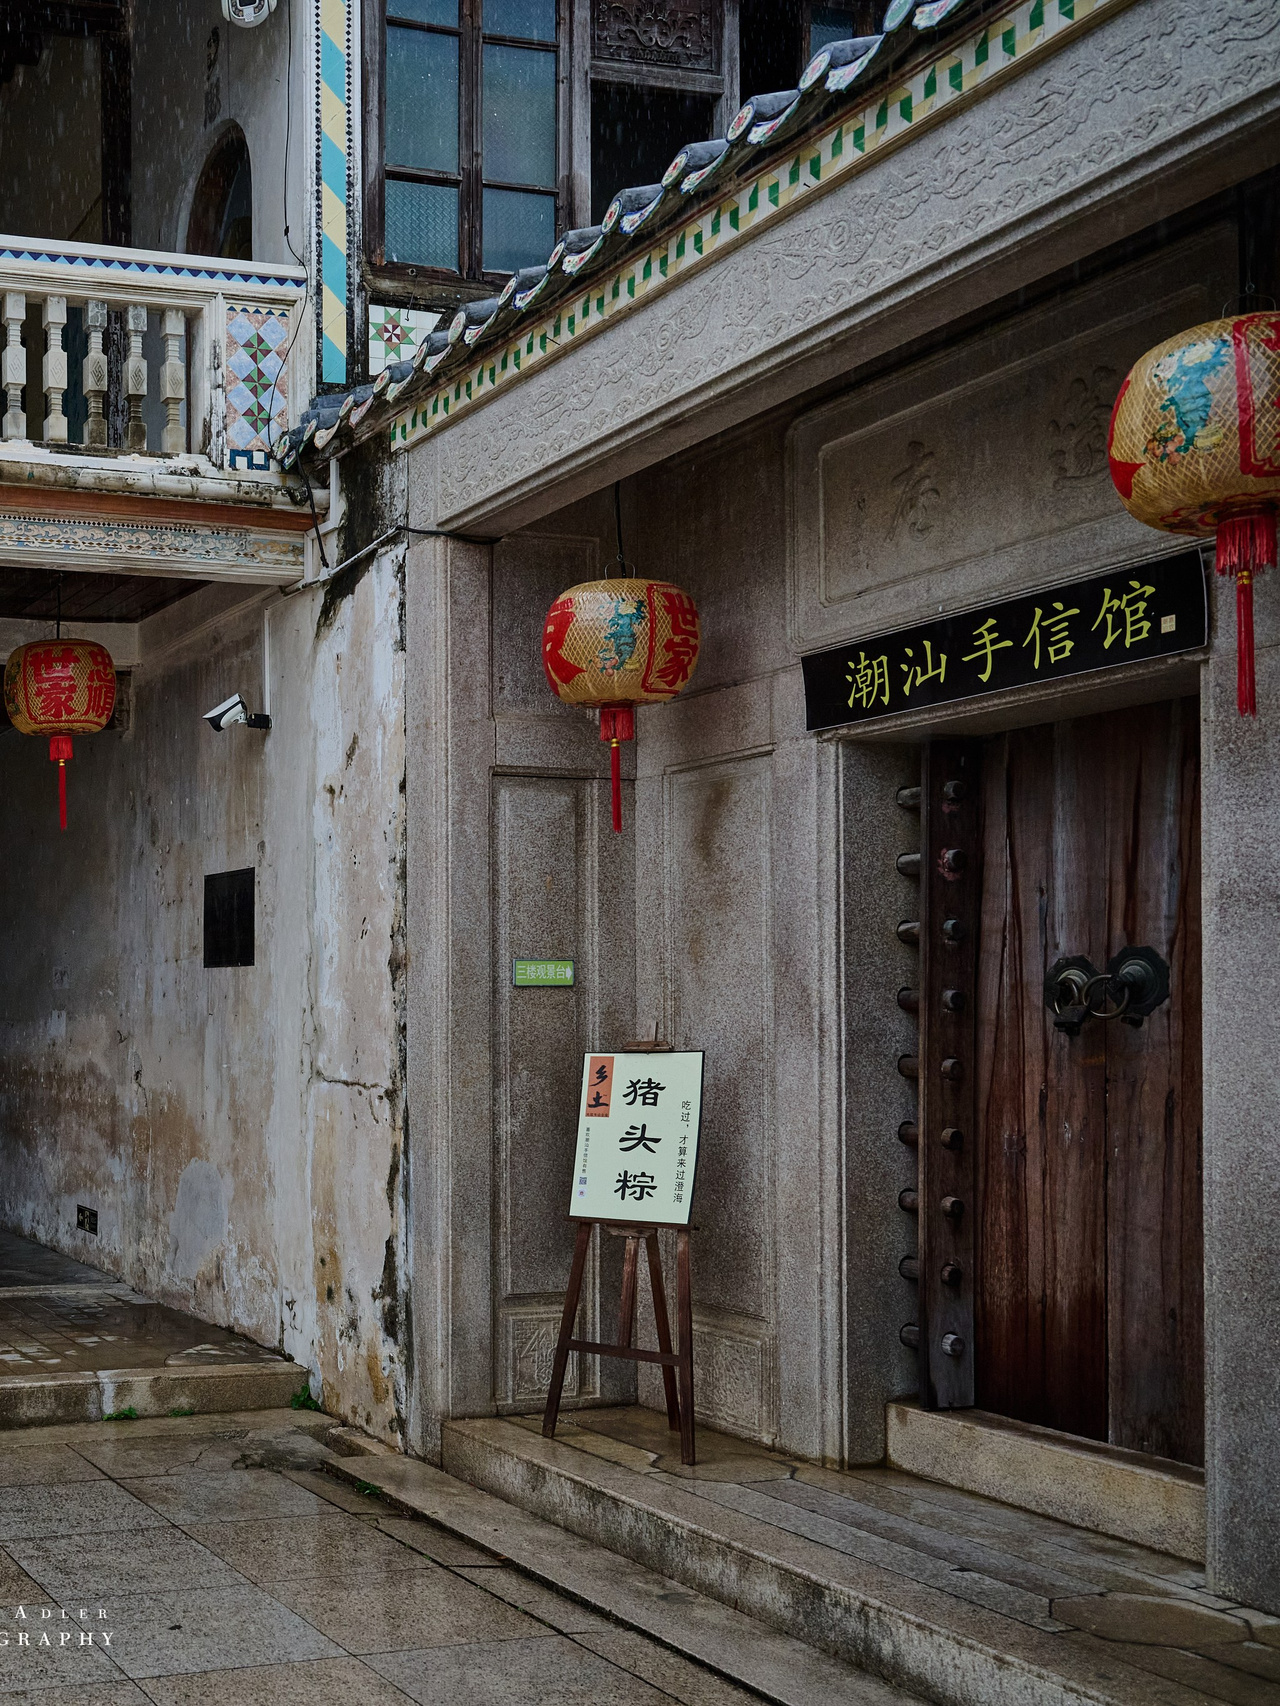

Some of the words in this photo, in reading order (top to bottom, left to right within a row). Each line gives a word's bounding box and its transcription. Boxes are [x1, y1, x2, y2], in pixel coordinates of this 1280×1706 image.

[845, 580, 1156, 709] 潮汕手信馆
[517, 964, 565, 979] 三楼观景台
[587, 1064, 609, 1109] 乡土
[614, 1077, 666, 1201] 猪头粽
